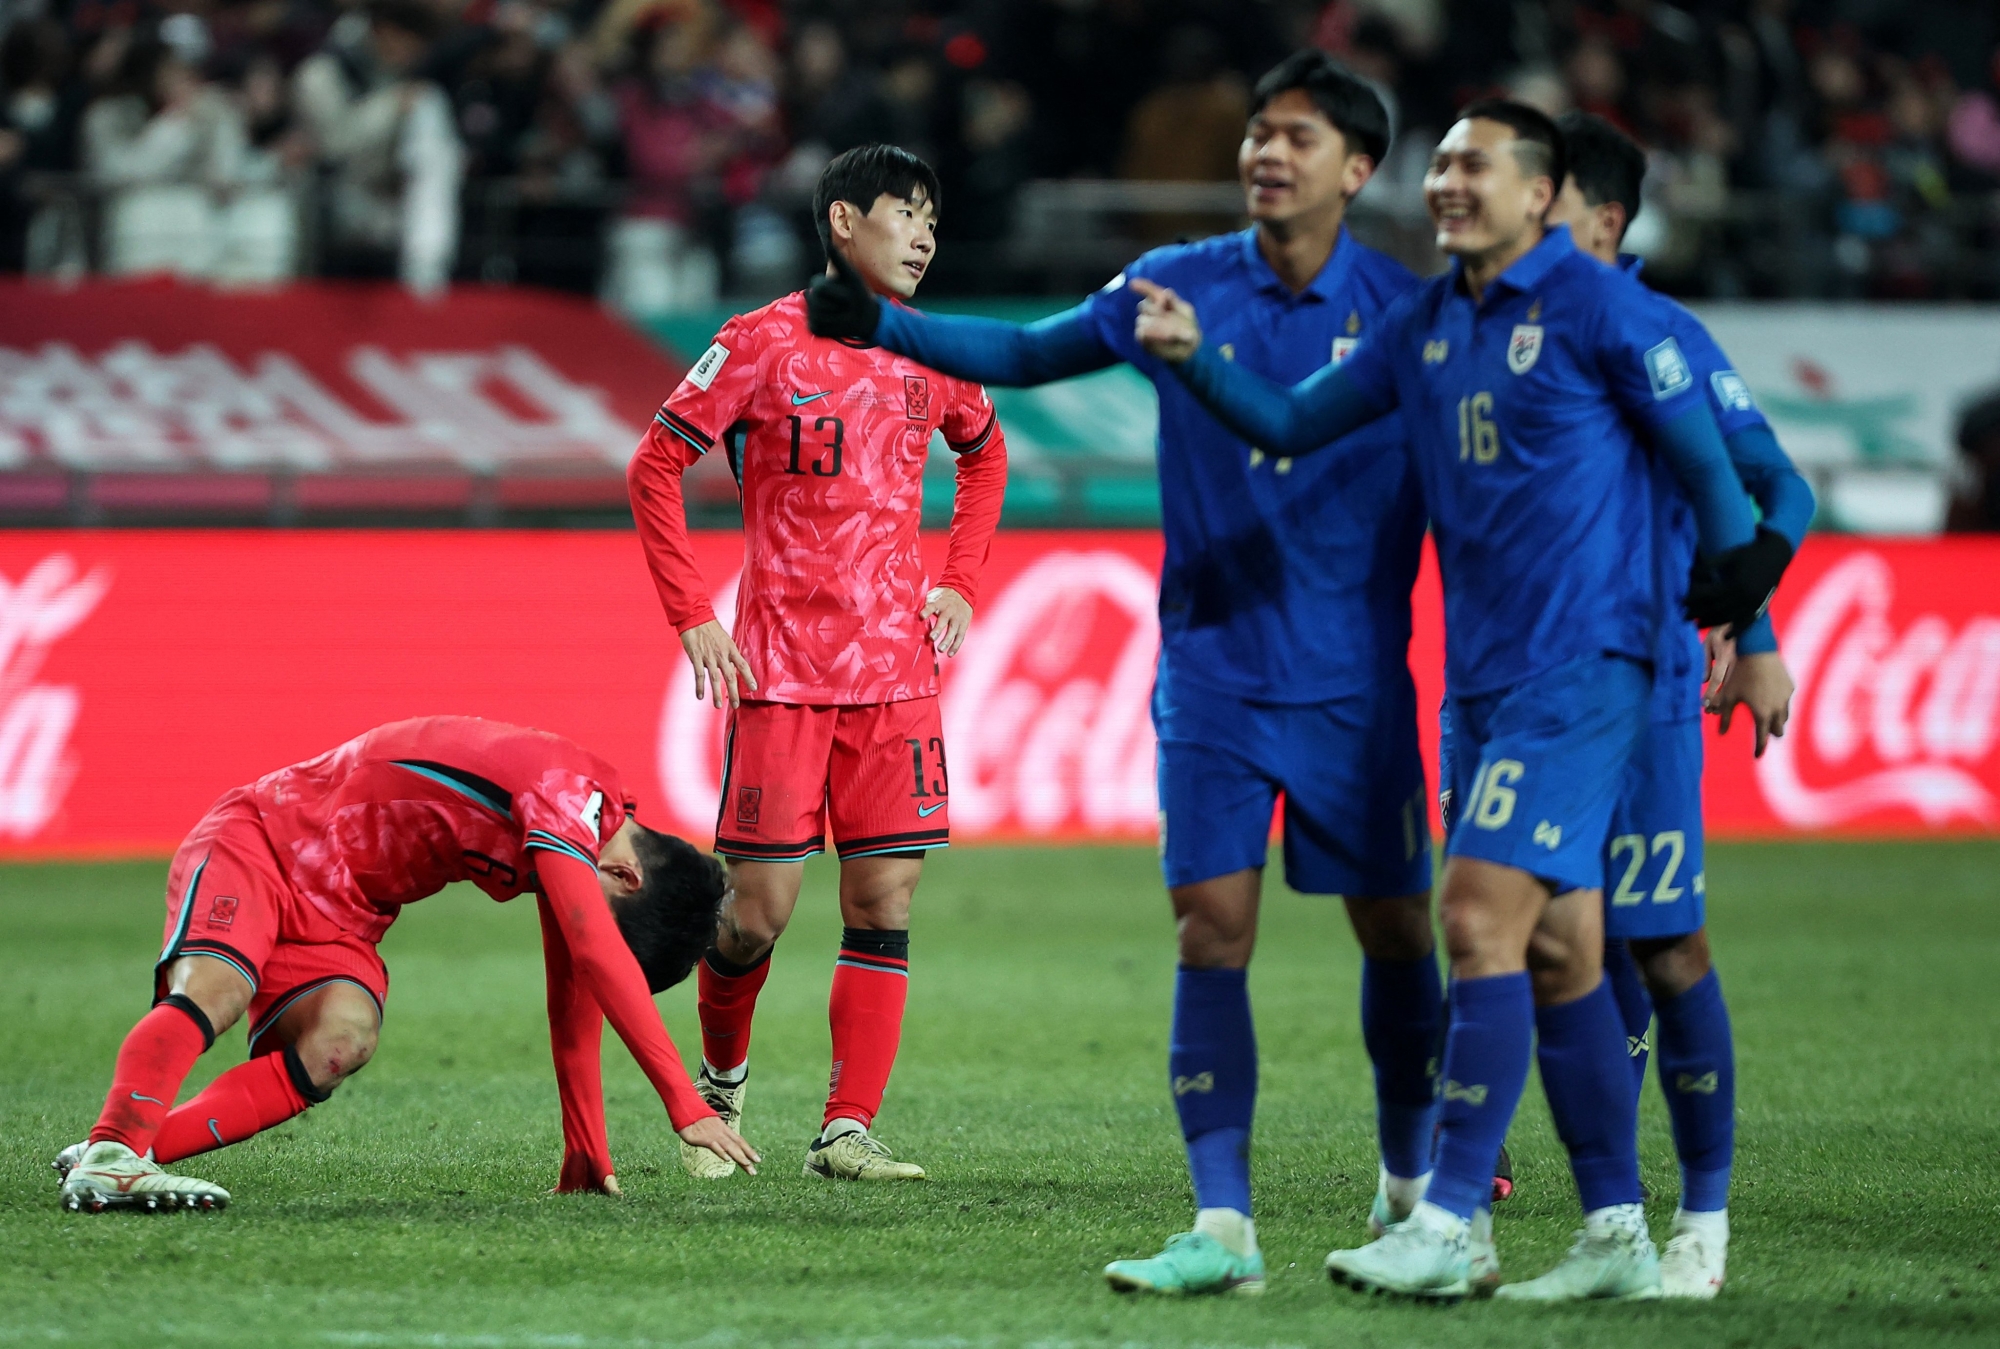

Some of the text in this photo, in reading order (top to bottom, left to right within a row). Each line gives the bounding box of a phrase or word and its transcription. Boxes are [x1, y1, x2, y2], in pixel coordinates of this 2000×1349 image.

[784, 415, 844, 477] 13
[906, 423, 927, 433] KOREA
[1457, 391, 1499, 465] 16
[905, 737, 949, 798] 13
[1462, 757, 1525, 832] 16
[463, 849, 518, 888] 9
[1610, 829, 1686, 906] 22
